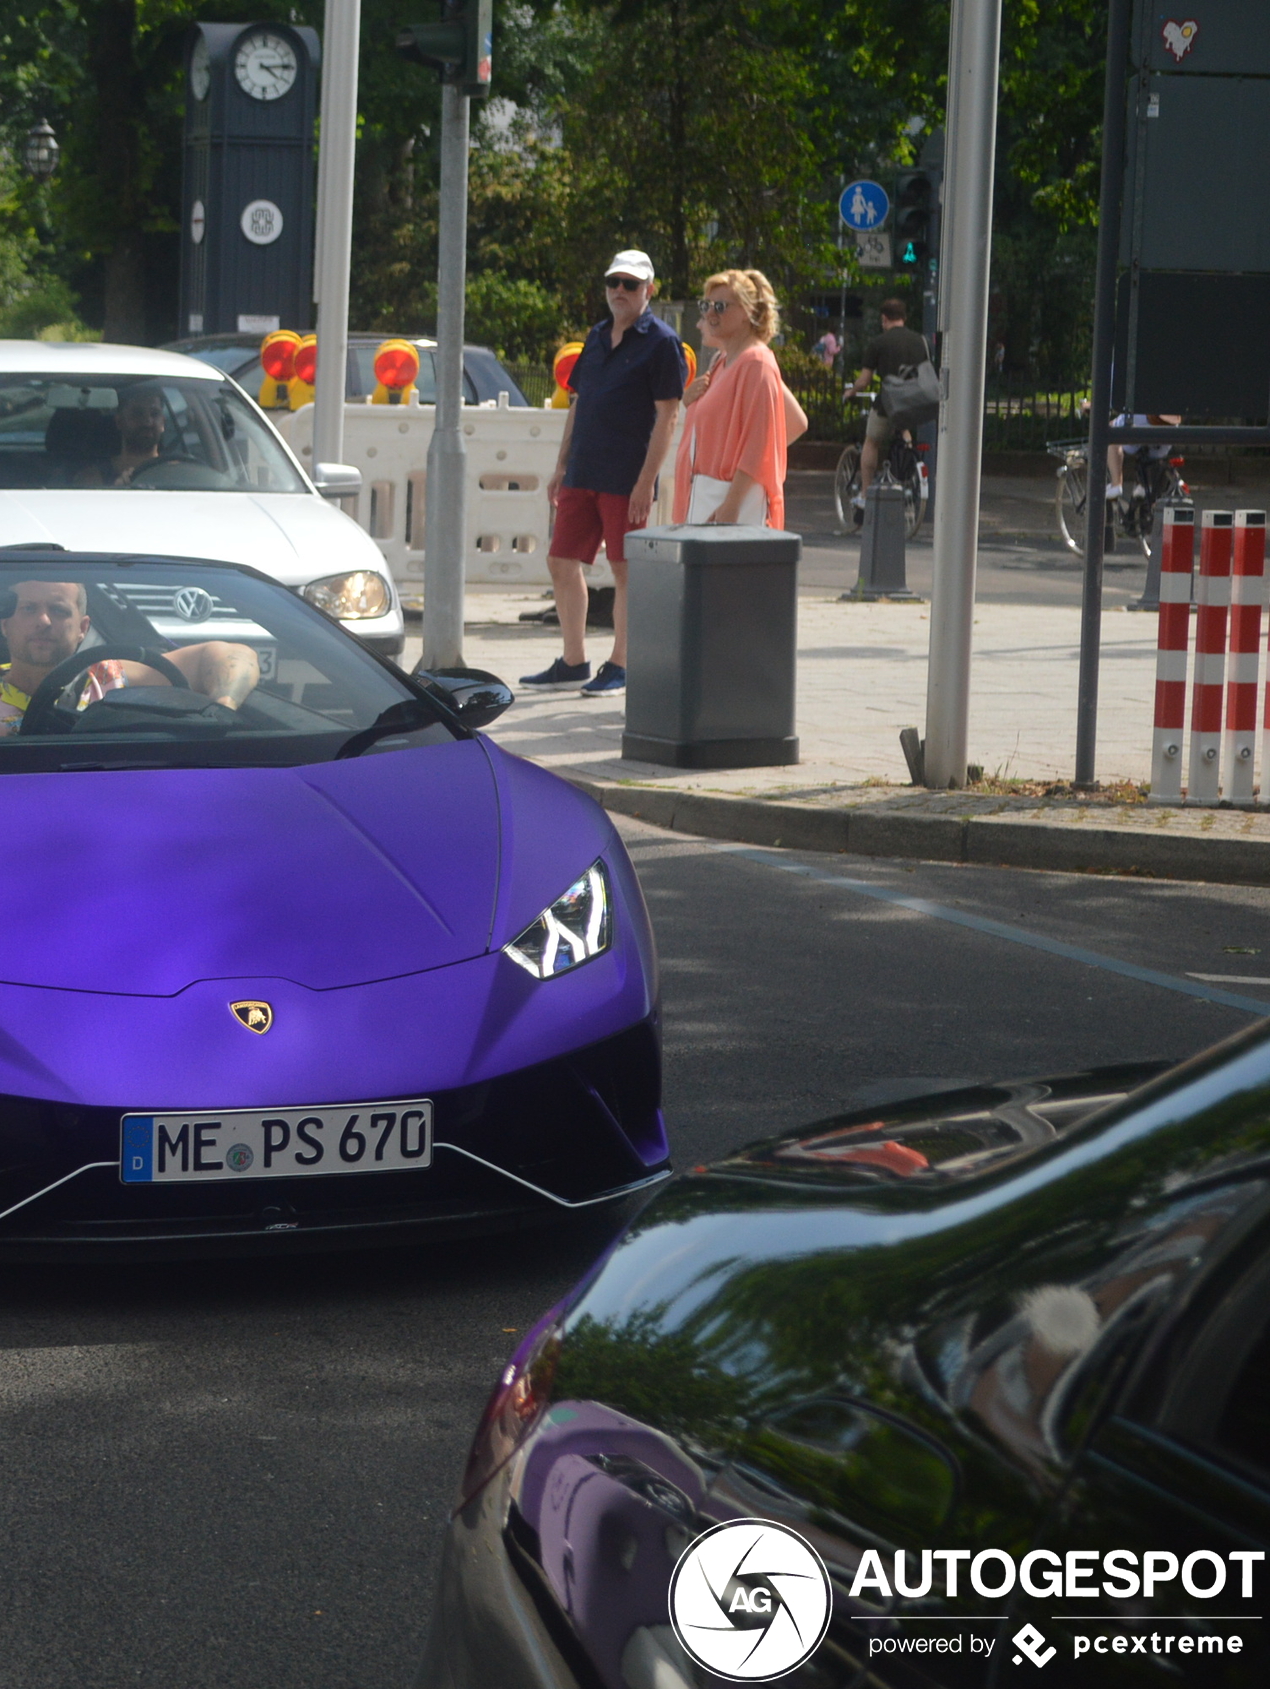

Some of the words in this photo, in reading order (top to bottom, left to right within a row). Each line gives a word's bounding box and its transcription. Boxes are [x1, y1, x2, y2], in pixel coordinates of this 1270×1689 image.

[157, 1121, 224, 1174] ME
[261, 1116, 325, 1168] PS
[338, 1109, 427, 1163] 670
[131, 1156, 144, 1171] D
